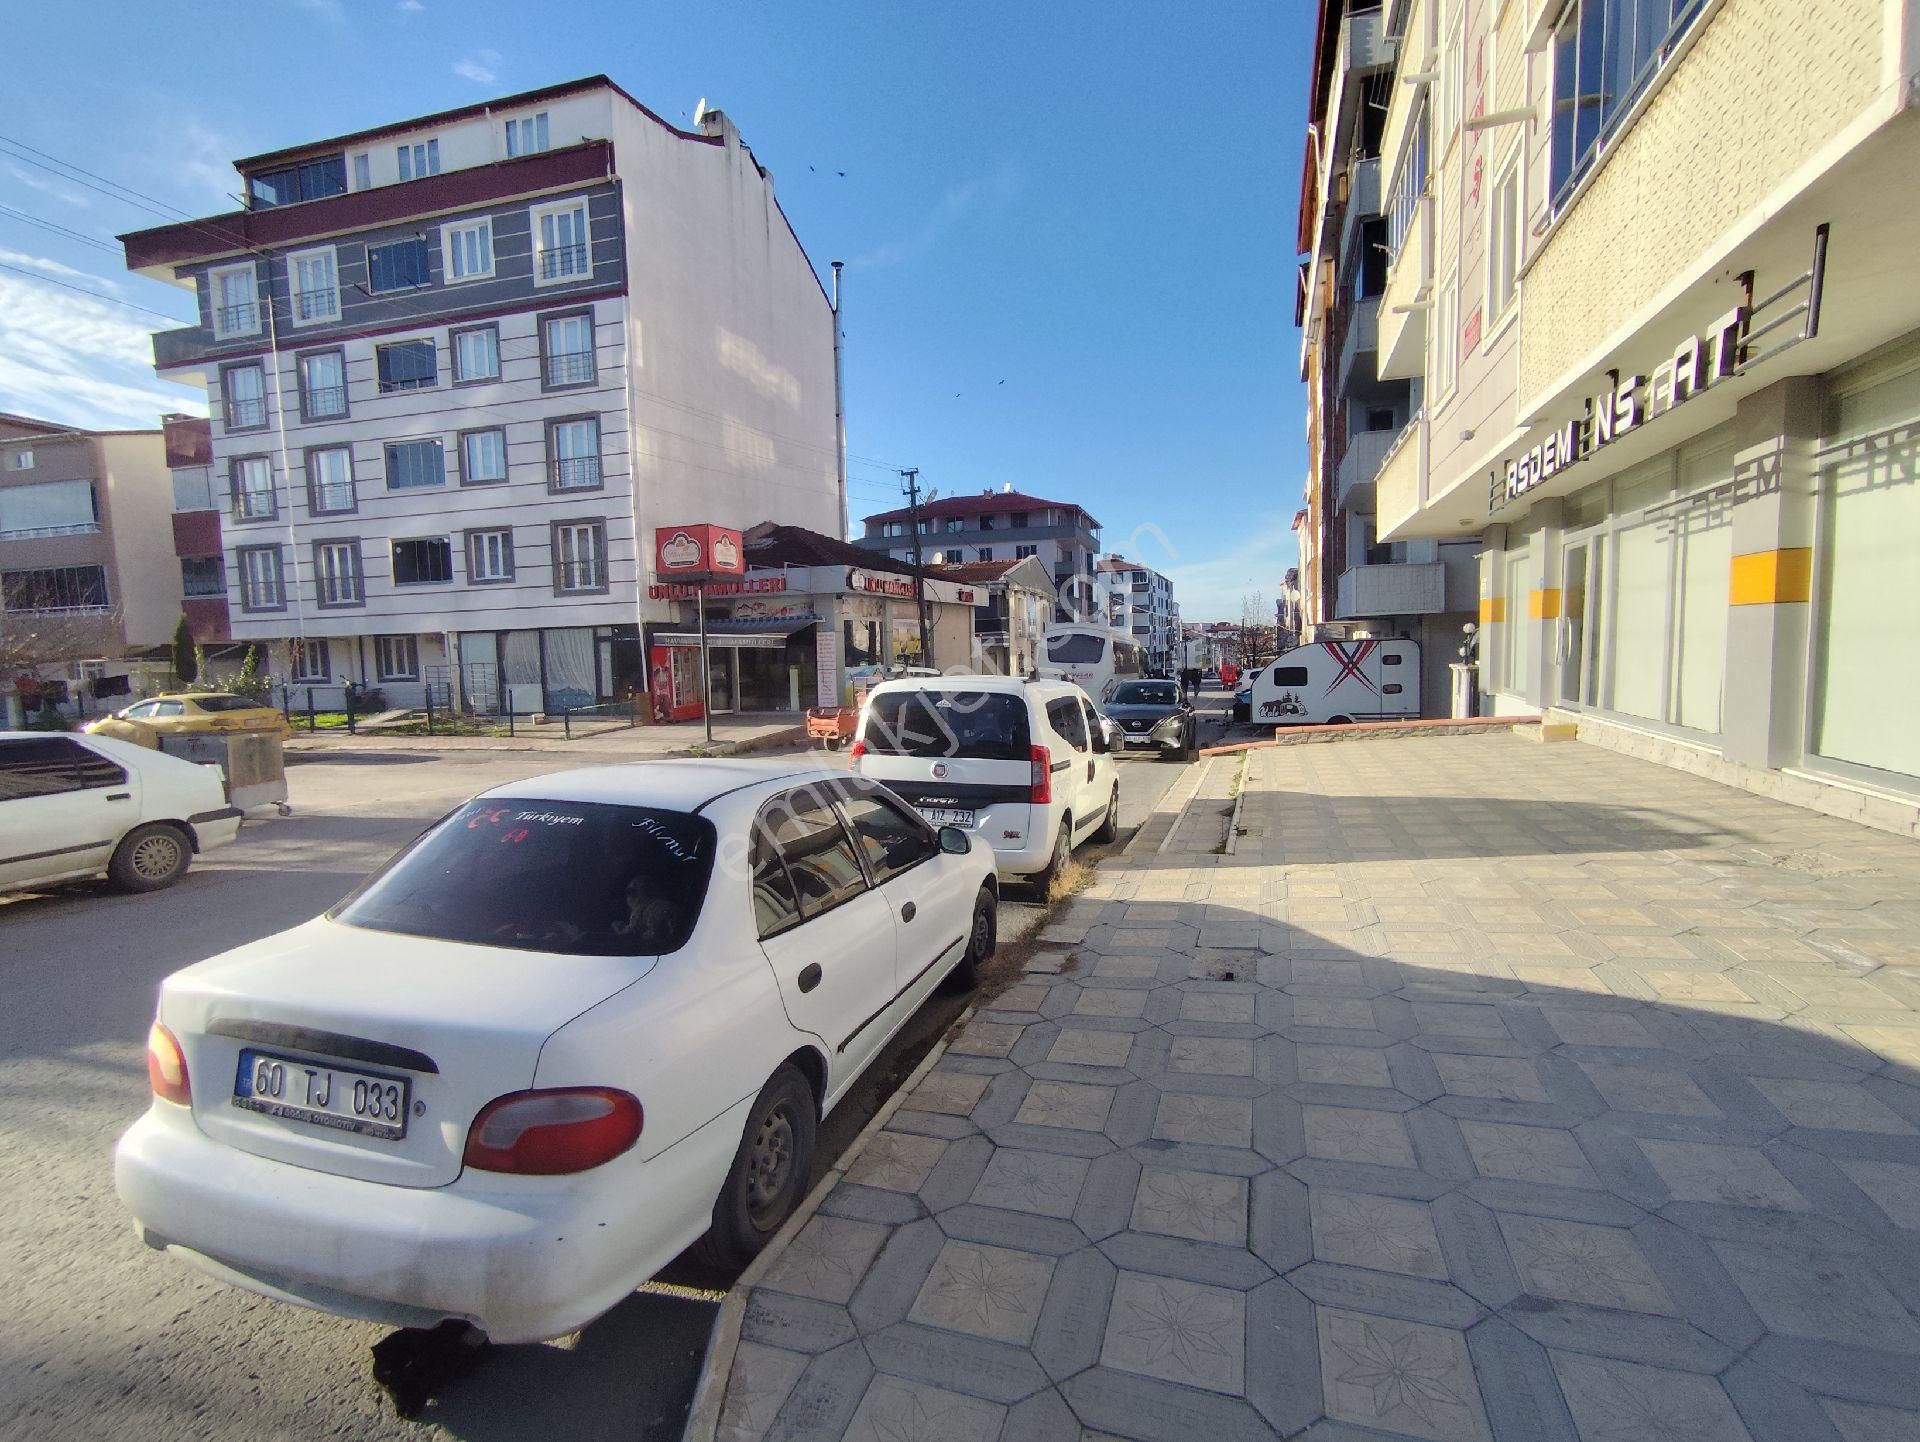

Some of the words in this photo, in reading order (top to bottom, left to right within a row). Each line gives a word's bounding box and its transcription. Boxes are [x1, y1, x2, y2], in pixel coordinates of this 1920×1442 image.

[953, 811, 972, 822] 232
[255, 1059, 284, 1098] 60
[304, 1069, 333, 1107] TJ
[353, 1079, 399, 1121] 033
